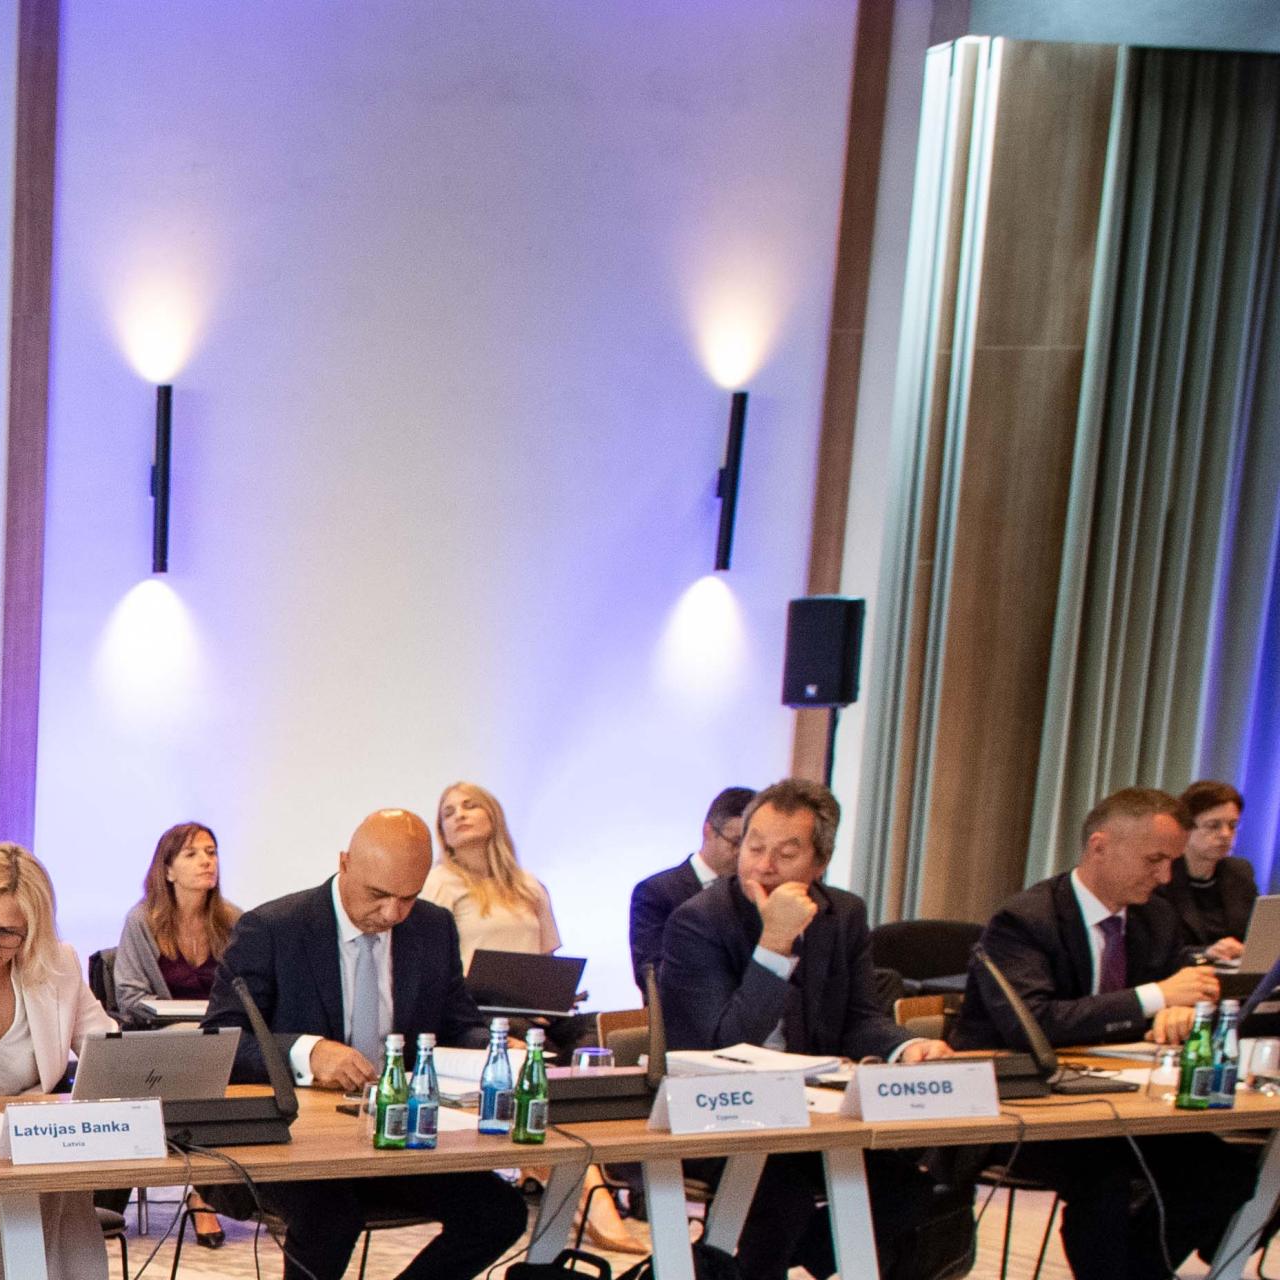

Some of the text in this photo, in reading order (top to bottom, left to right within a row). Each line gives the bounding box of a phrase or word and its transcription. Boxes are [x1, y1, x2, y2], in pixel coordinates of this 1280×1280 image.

[878, 1081, 953, 1097] CONSOB
[696, 1091, 755, 1111] CySEC
[14, 1120, 130, 1138] Latvijas Banka
